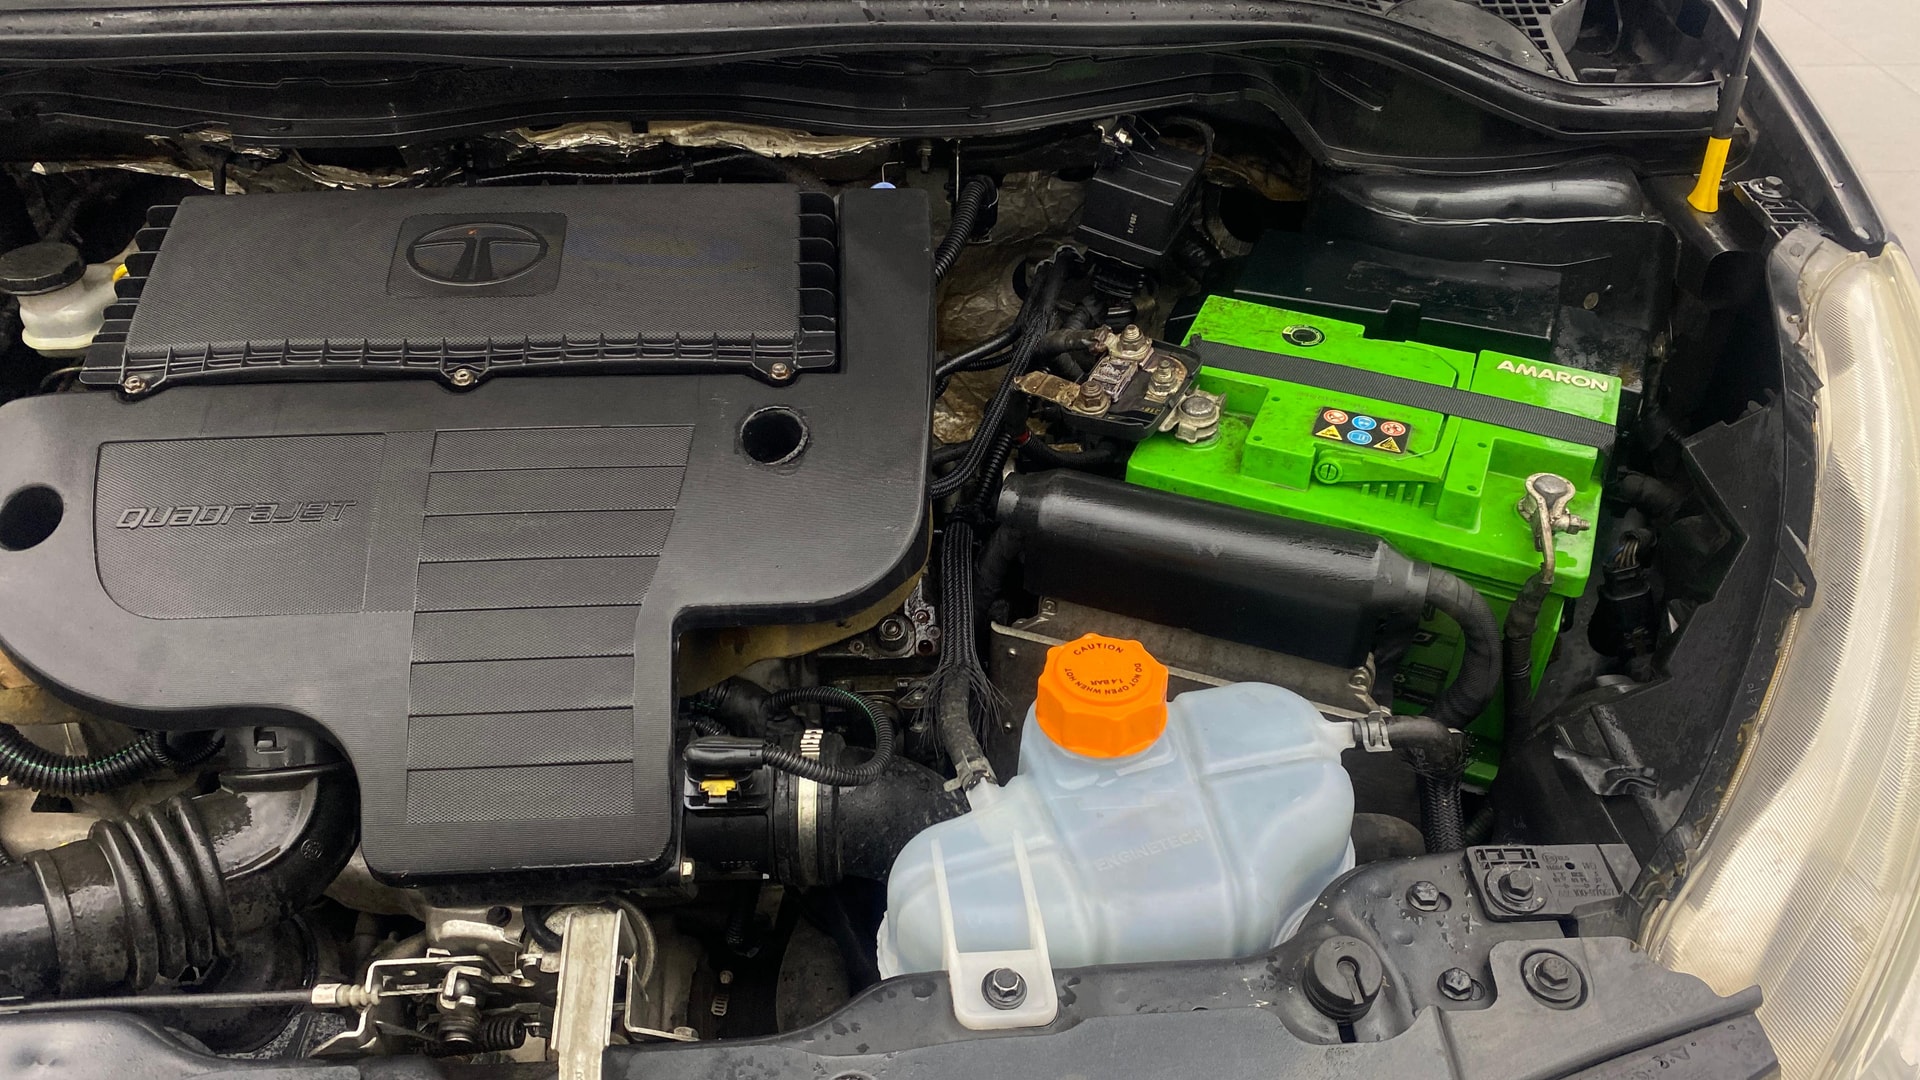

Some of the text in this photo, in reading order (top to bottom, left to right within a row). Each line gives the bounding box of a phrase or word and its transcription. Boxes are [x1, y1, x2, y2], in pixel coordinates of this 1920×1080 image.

[1496, 360, 1609, 392] AMARON
[1073, 642, 1125, 656] CAUTION
[1064, 663, 1143, 695] DO NOT OPEN WHEN HOT
[1094, 828, 1204, 872] ENGINETECH
